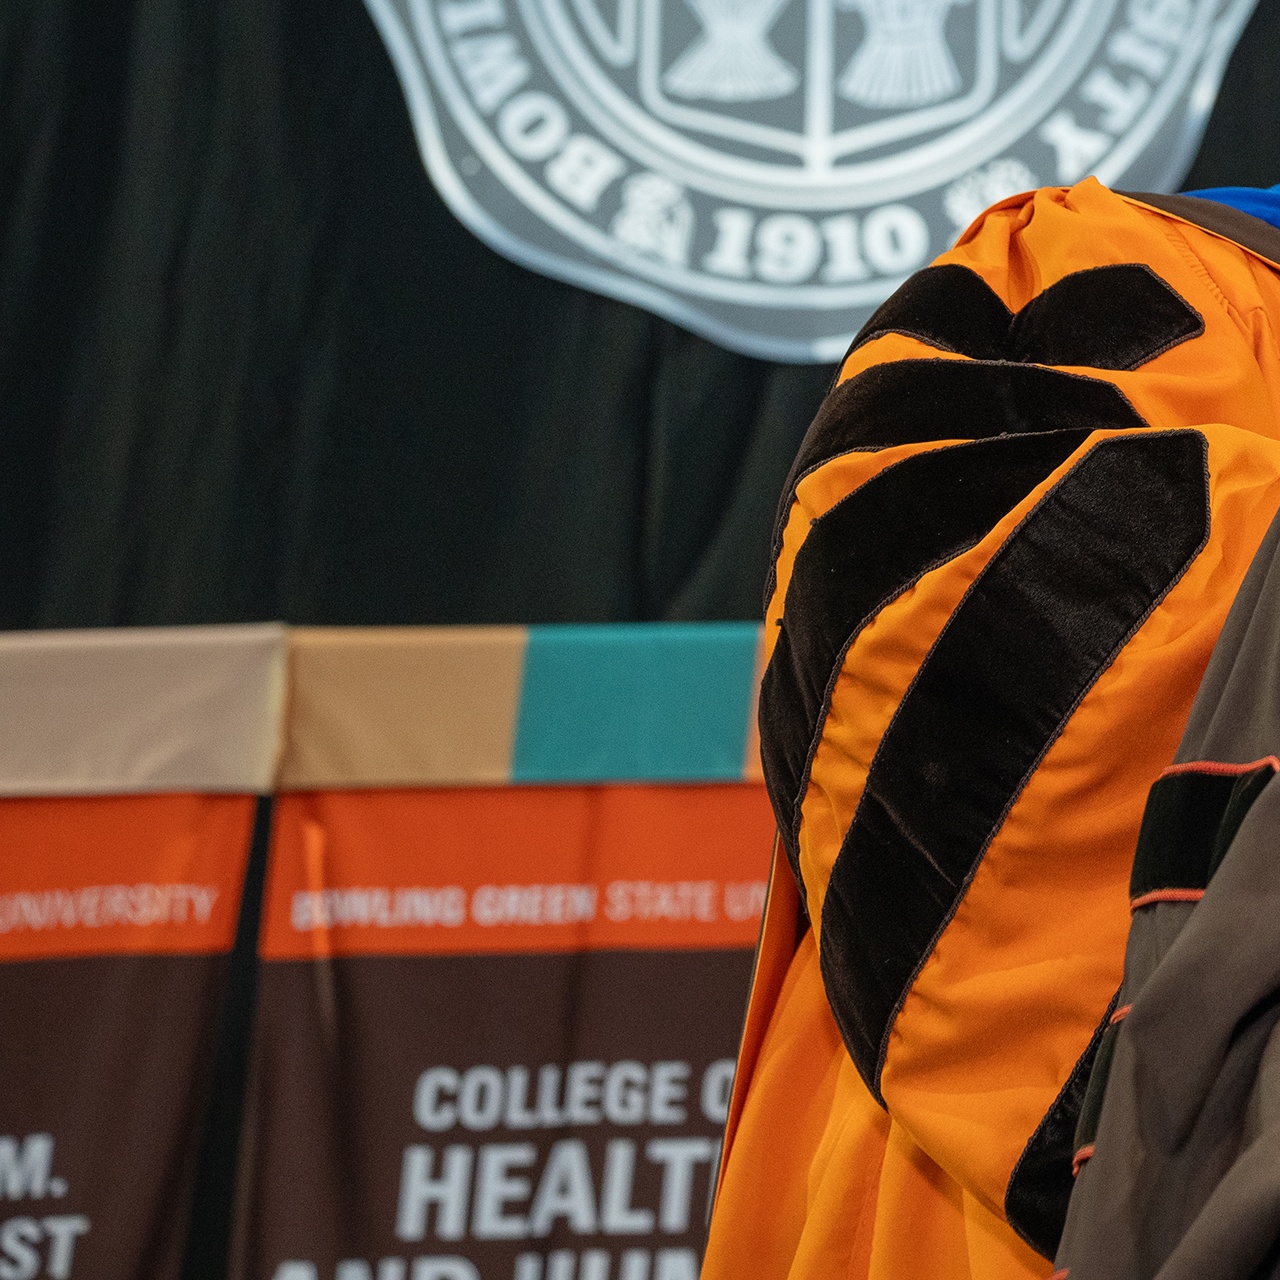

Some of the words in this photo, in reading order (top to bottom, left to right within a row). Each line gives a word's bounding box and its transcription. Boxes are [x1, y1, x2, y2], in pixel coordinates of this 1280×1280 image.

[706, 203, 931, 285] 1910
[291, 884, 466, 931] BOWLING
[471, 884, 597, 927] GREEN
[604, 880, 720, 923] STATE
[413, 1060, 690, 1132] COLLEGE
[396, 1137, 722, 1242] HEALT
